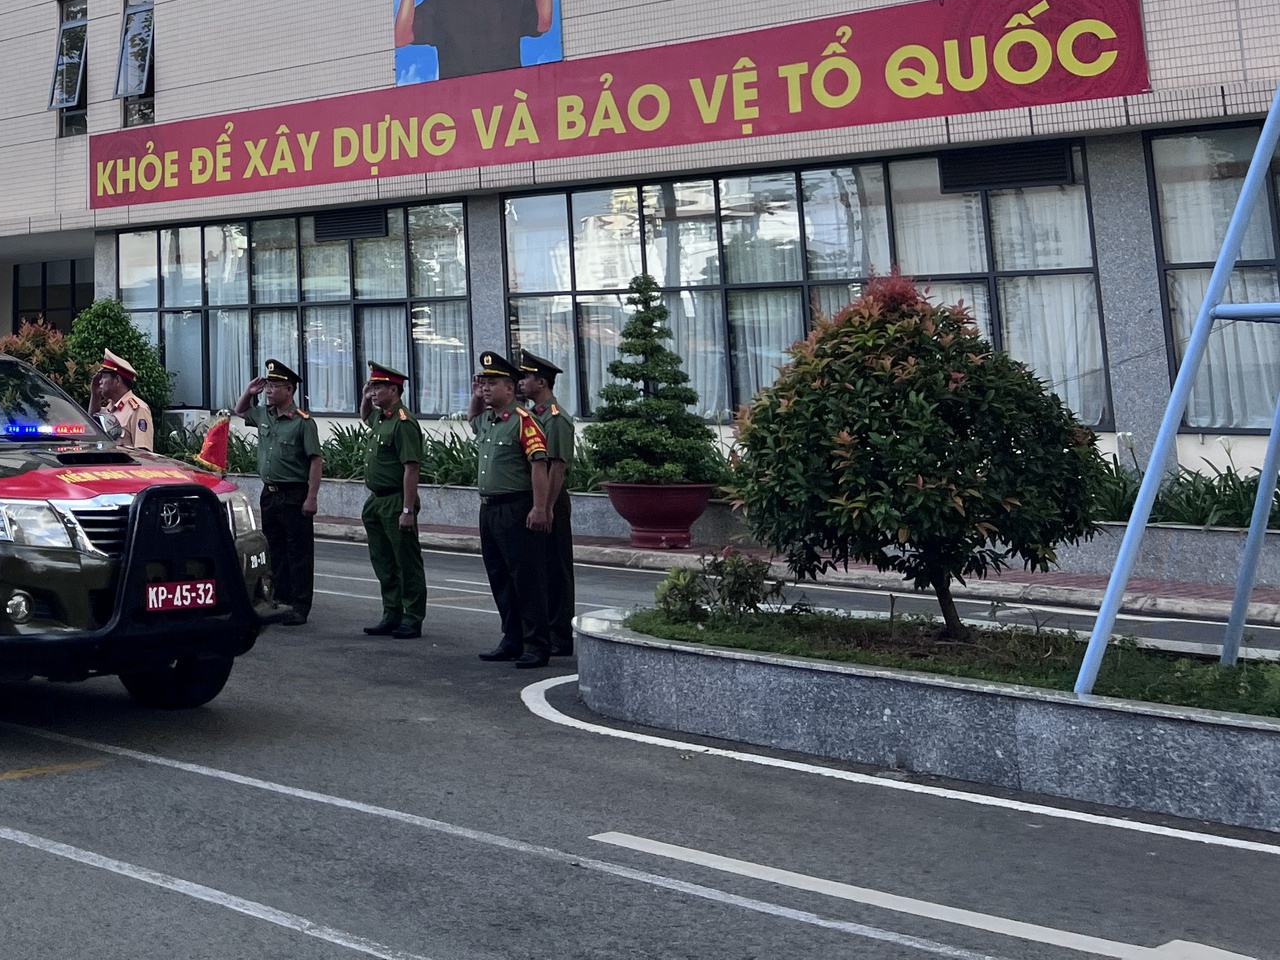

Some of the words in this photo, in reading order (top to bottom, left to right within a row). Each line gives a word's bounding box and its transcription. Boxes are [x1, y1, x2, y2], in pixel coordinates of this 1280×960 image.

[96, 141, 179, 197] KHỎE
[189, 121, 234, 185] ĐỂ
[242, 124, 320, 179] XÂY
[333, 112, 457, 175] DỰNG
[471, 89, 540, 150] VÀ
[557, 72, 670, 141] BẢO
[689, 57, 760, 135] VỆ
[778, 25, 862, 114] TỔ
[884, 0, 1119, 99] QUỐC
[148, 583, 214, 609] KP-45-32
